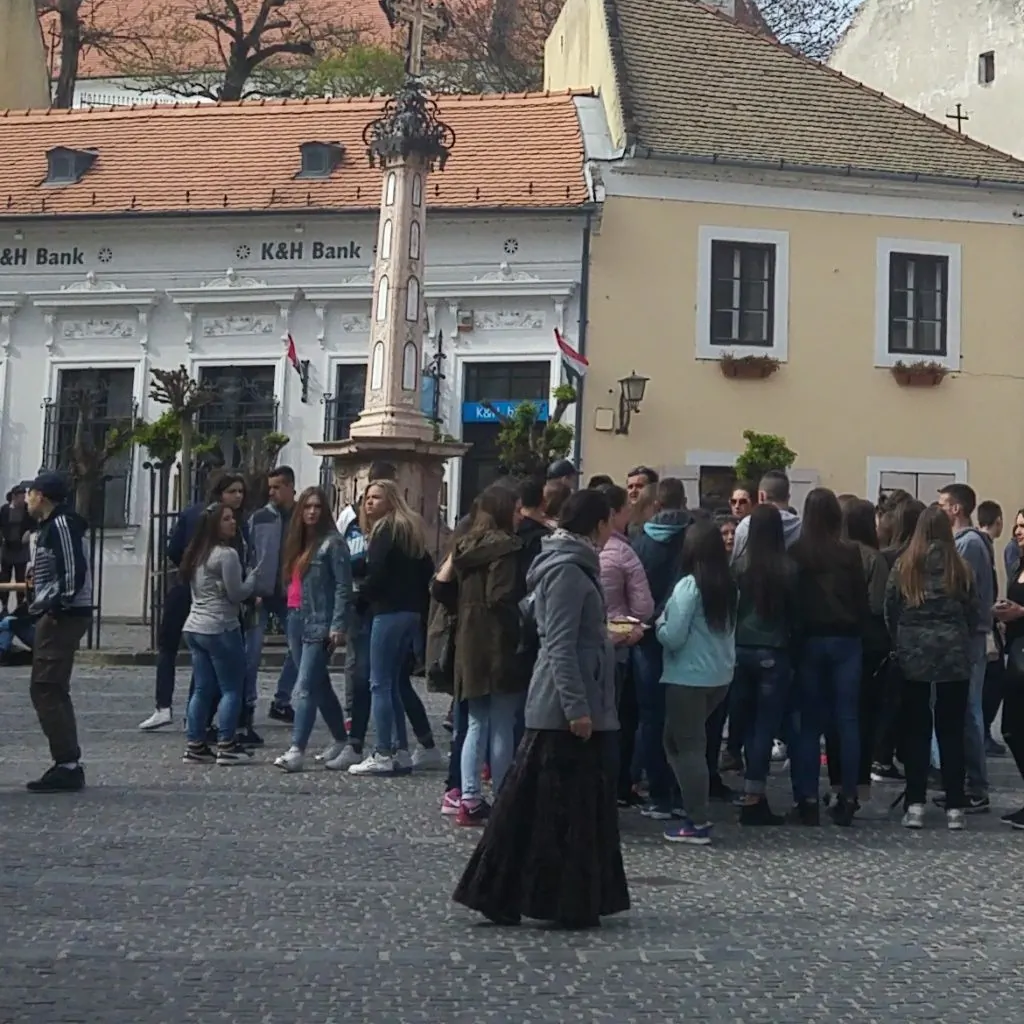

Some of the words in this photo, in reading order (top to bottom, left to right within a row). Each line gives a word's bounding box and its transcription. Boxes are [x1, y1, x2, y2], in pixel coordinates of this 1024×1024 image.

[0, 248, 28, 266] &H
[36, 247, 84, 265] Bank
[261, 242, 303, 260] K&H
[312, 241, 362, 259] Bank
